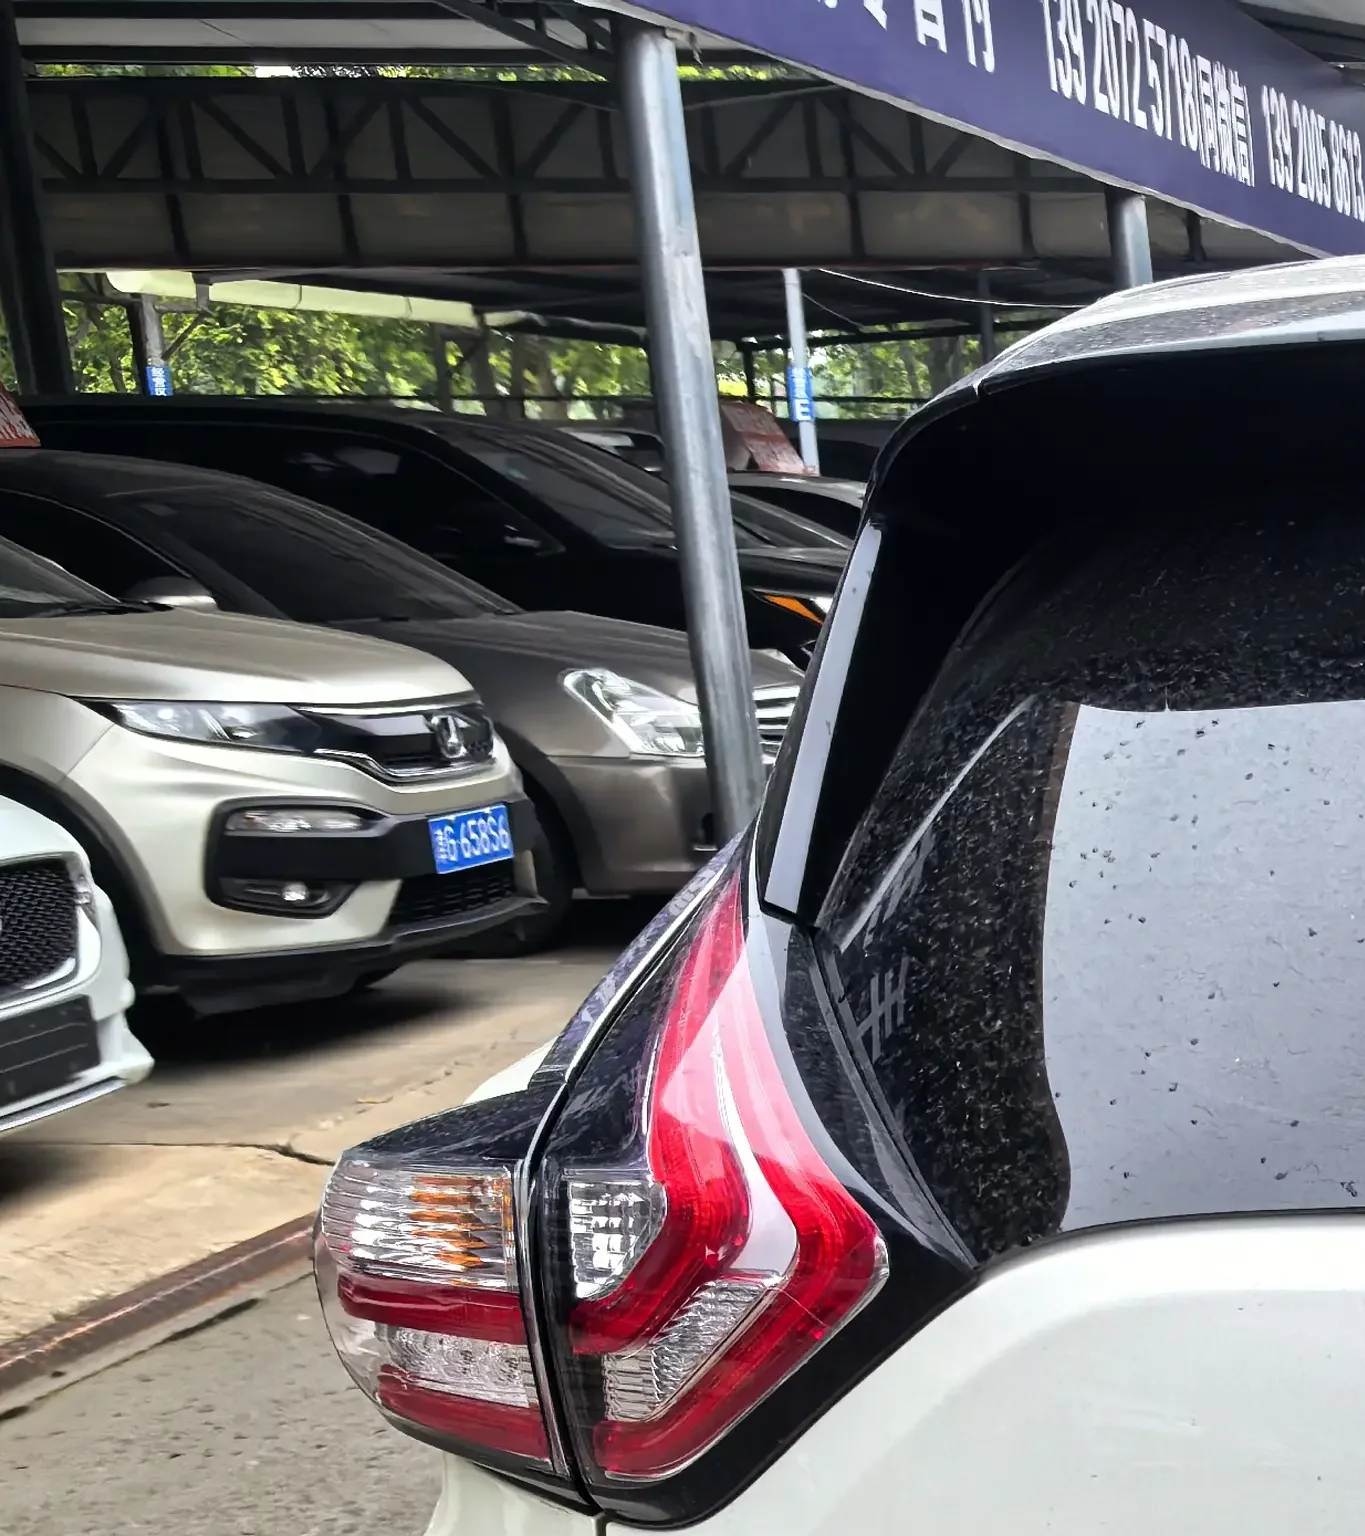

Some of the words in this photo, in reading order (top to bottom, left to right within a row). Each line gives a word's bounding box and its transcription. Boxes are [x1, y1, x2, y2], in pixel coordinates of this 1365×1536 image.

[1042, 0, 1086, 106] 139
[1085, 0, 1148, 131] 2072
[1261, 84, 1294, 194] 139
[1292, 99, 1331, 209] 2005
